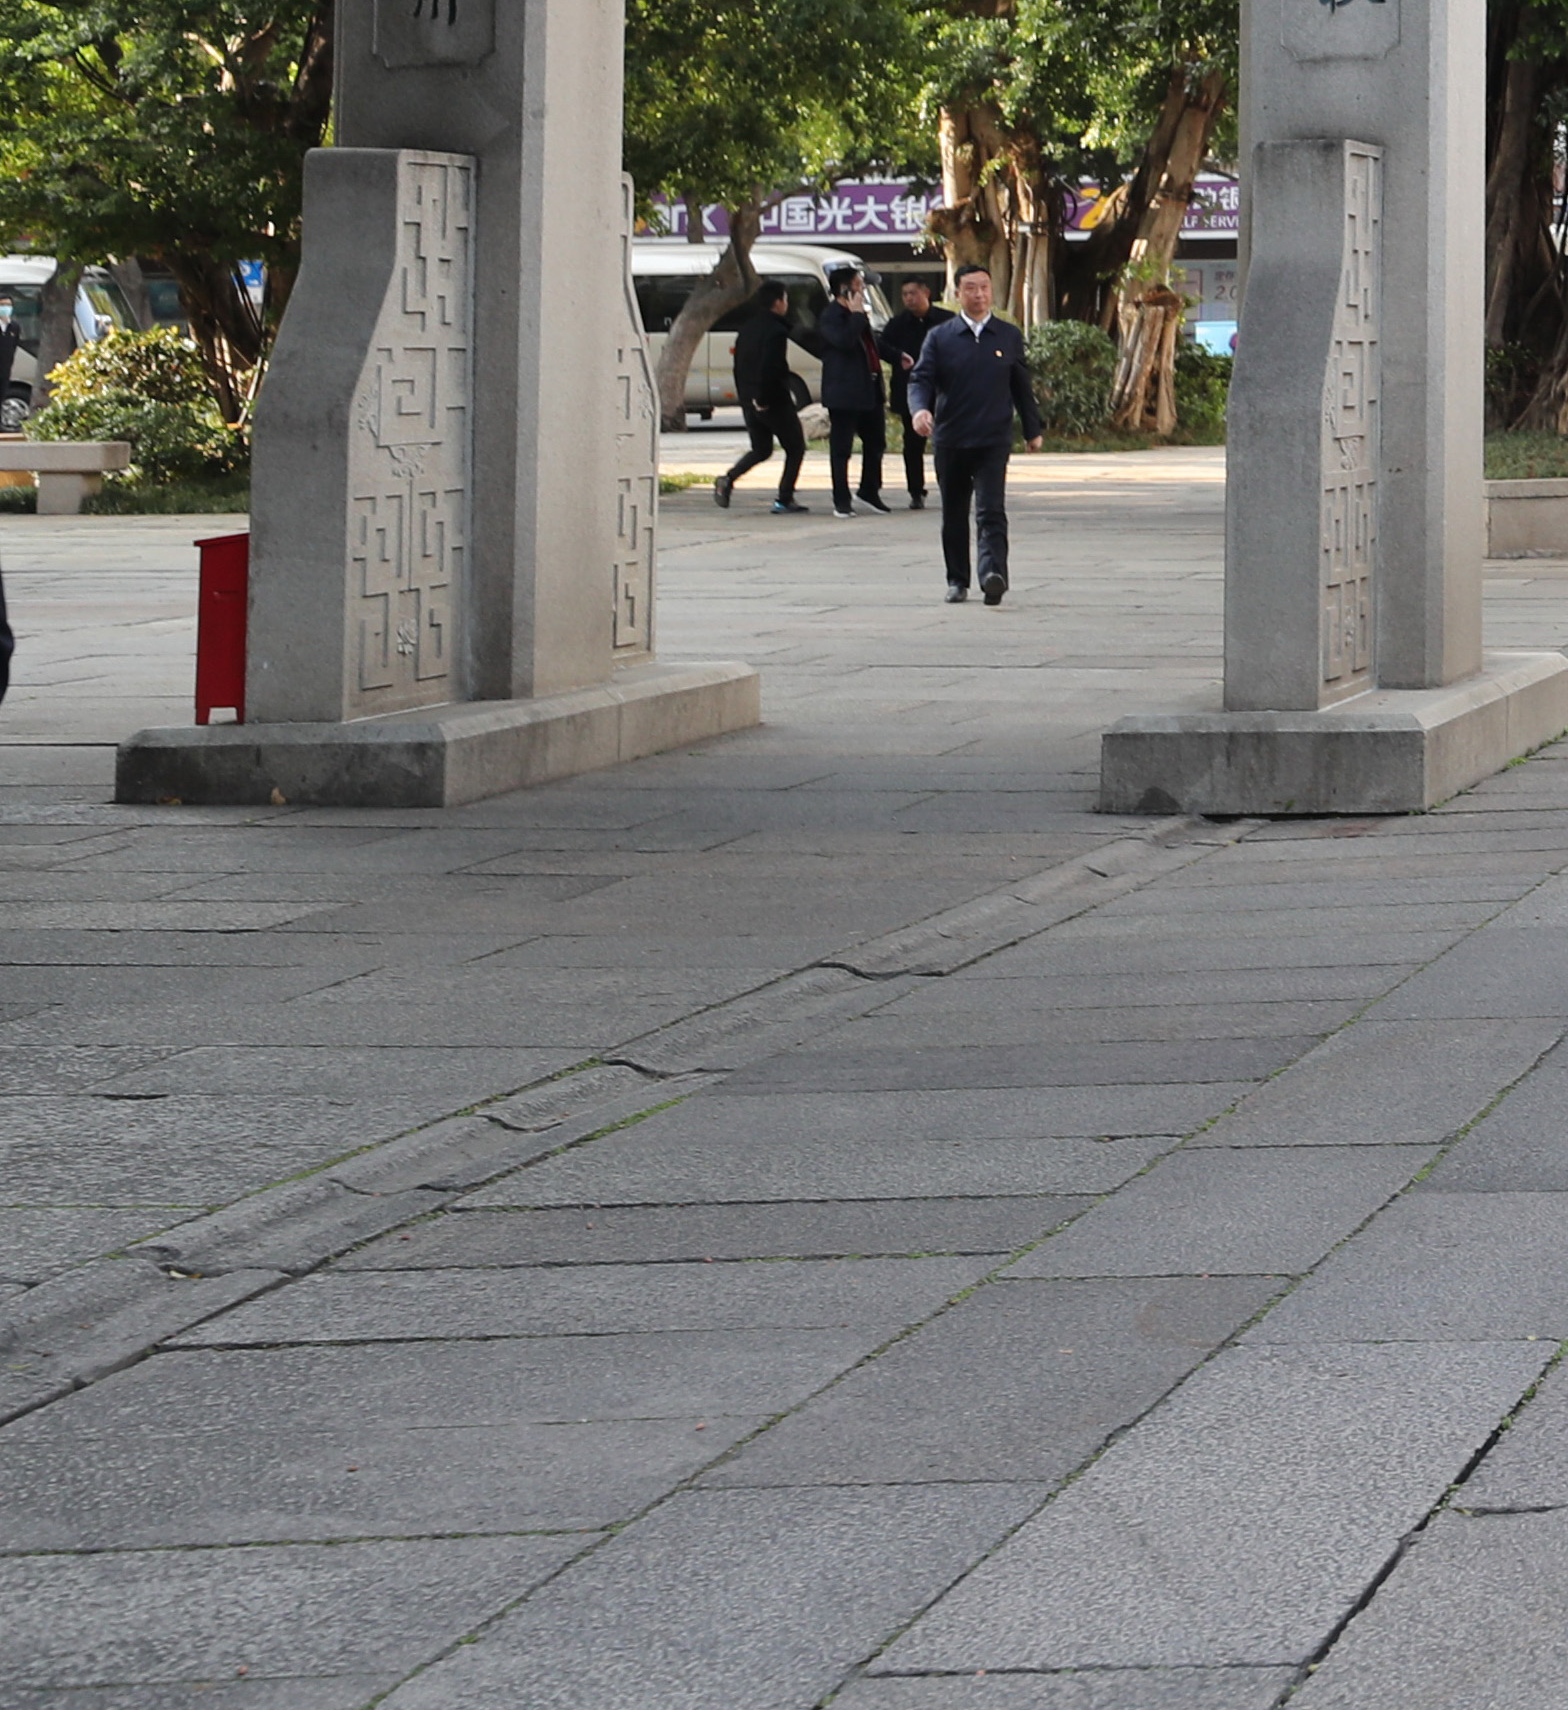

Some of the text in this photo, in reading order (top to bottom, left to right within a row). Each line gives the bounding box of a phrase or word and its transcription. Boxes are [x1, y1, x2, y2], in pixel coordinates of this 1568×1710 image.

[759, 194, 944, 233] 中国光大银
